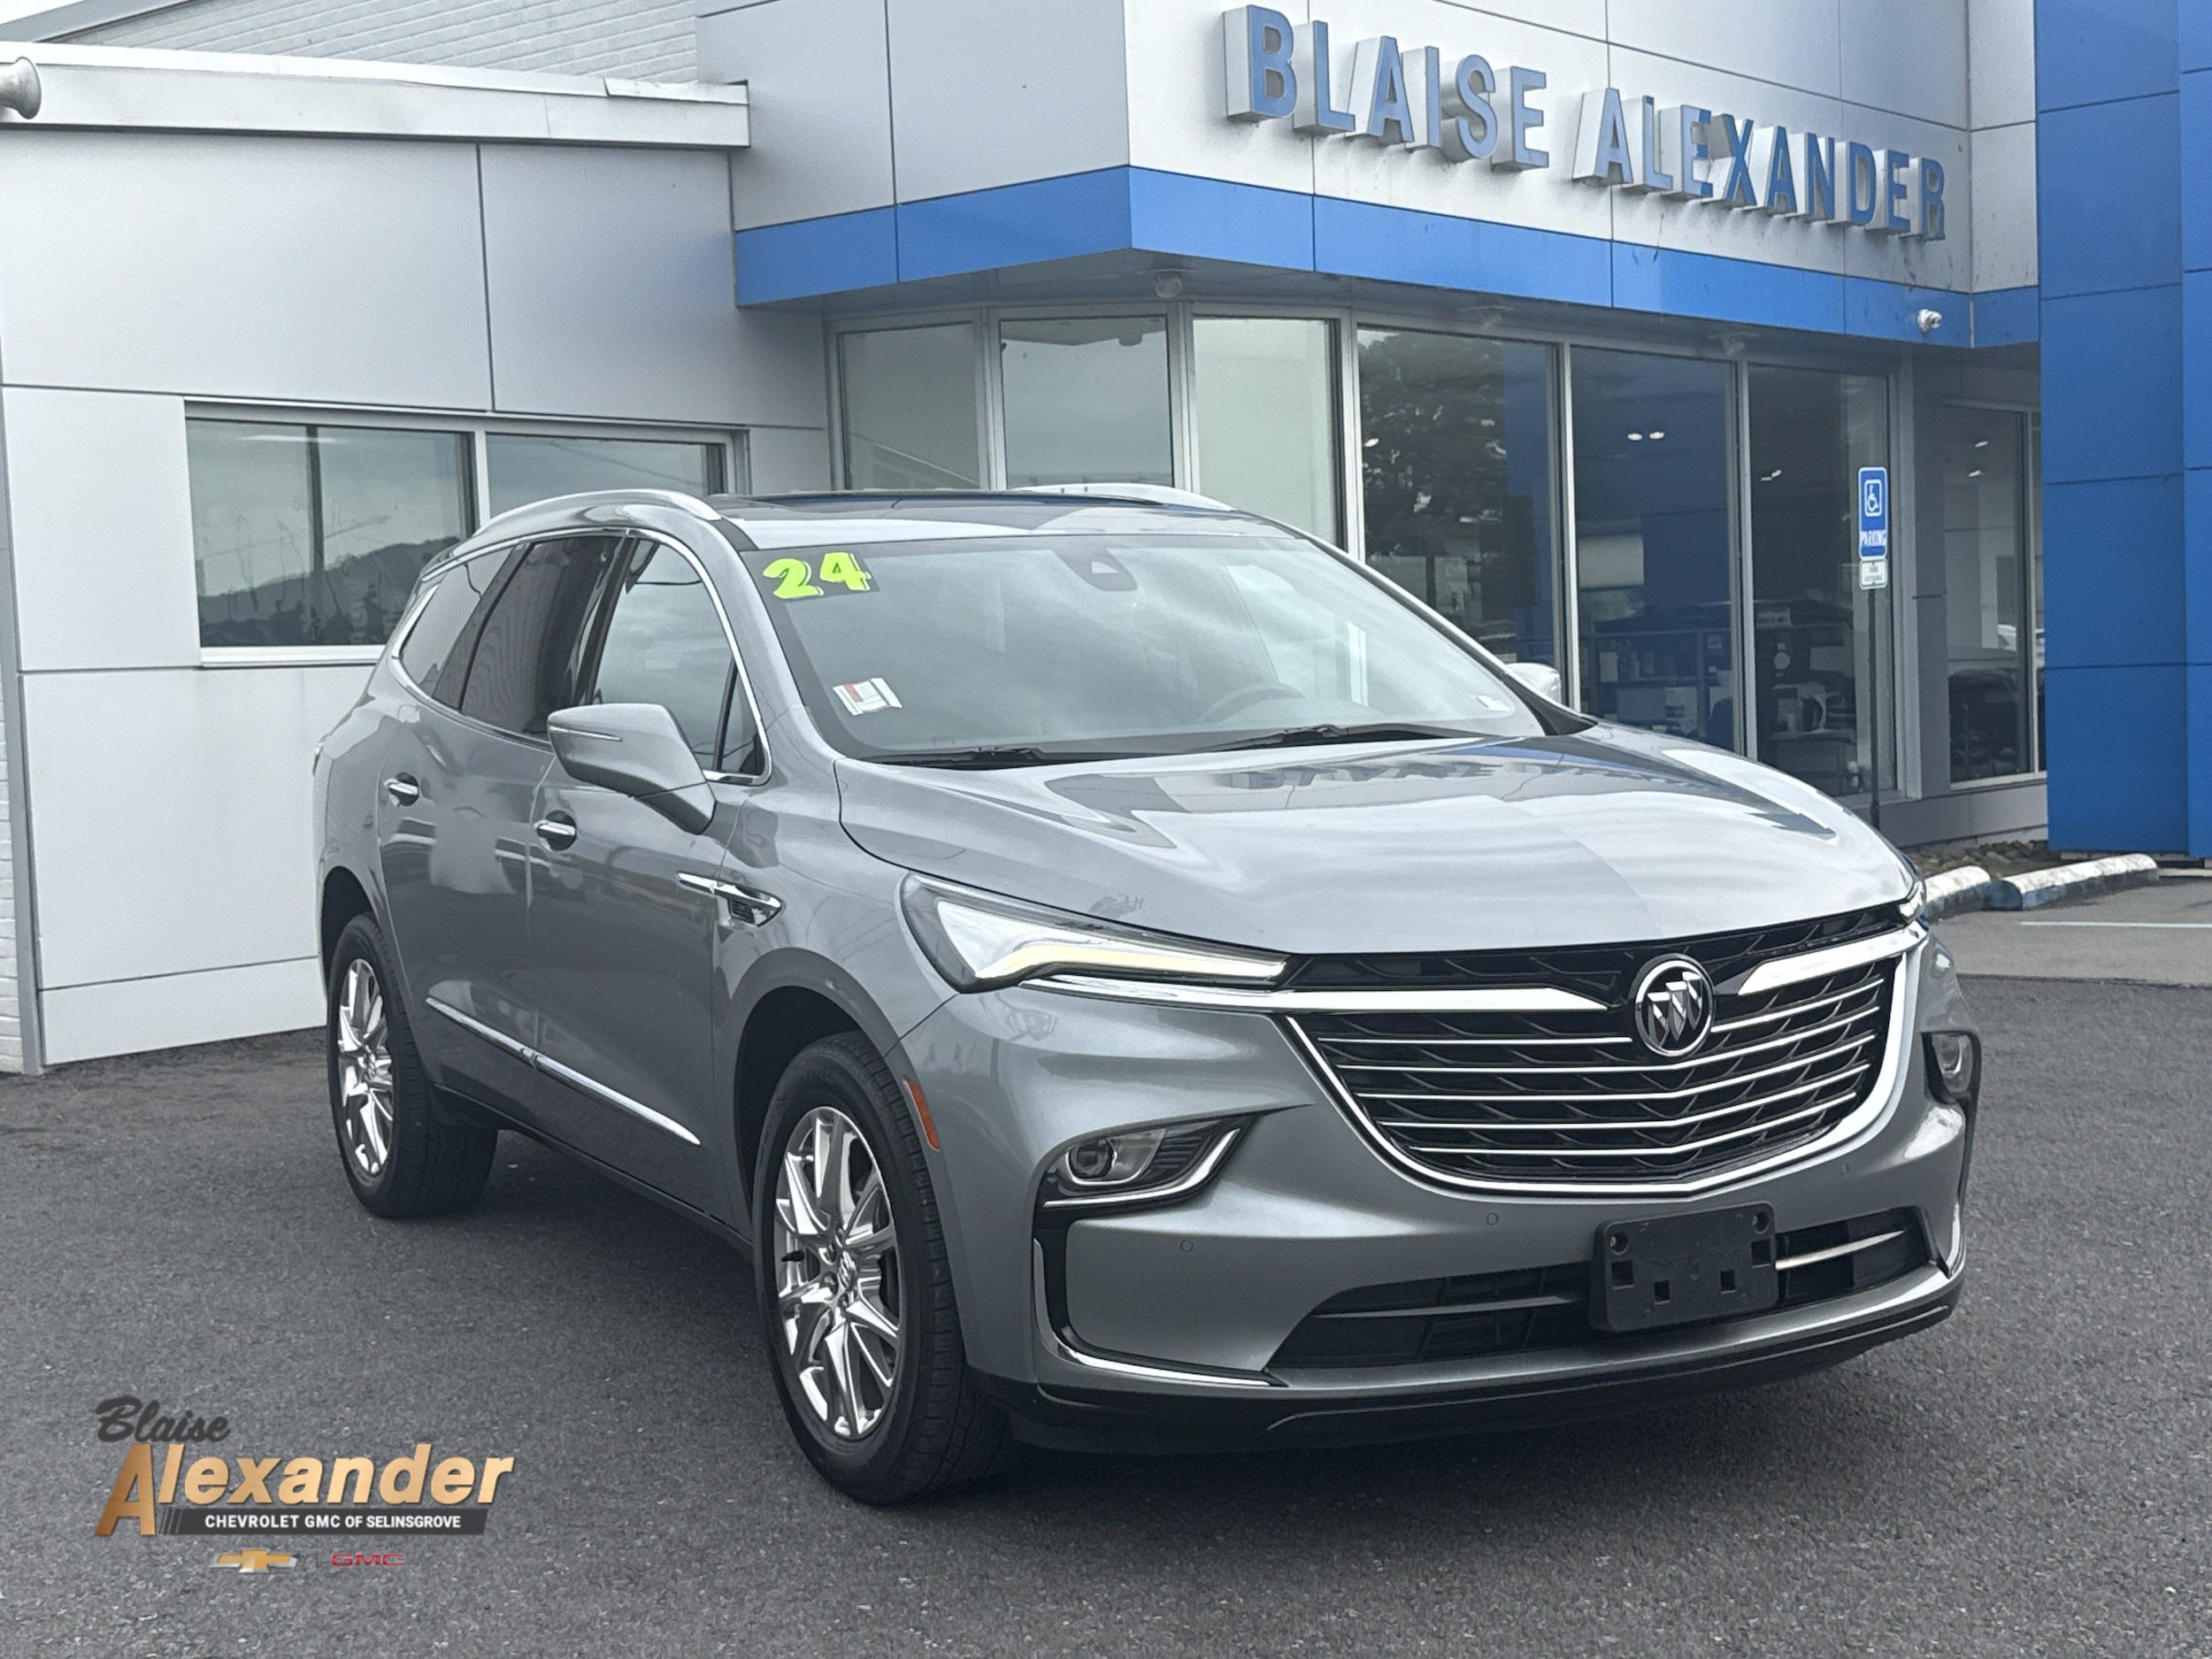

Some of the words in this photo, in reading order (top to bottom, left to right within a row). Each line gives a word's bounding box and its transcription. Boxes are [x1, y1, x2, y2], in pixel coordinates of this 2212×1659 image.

[1225, 5, 1549, 171] BLAISE
[1574, 87, 1946, 241] ALEXANDER
[1860, 530, 1886, 547] PARKING
[763, 551, 872, 599] 24
